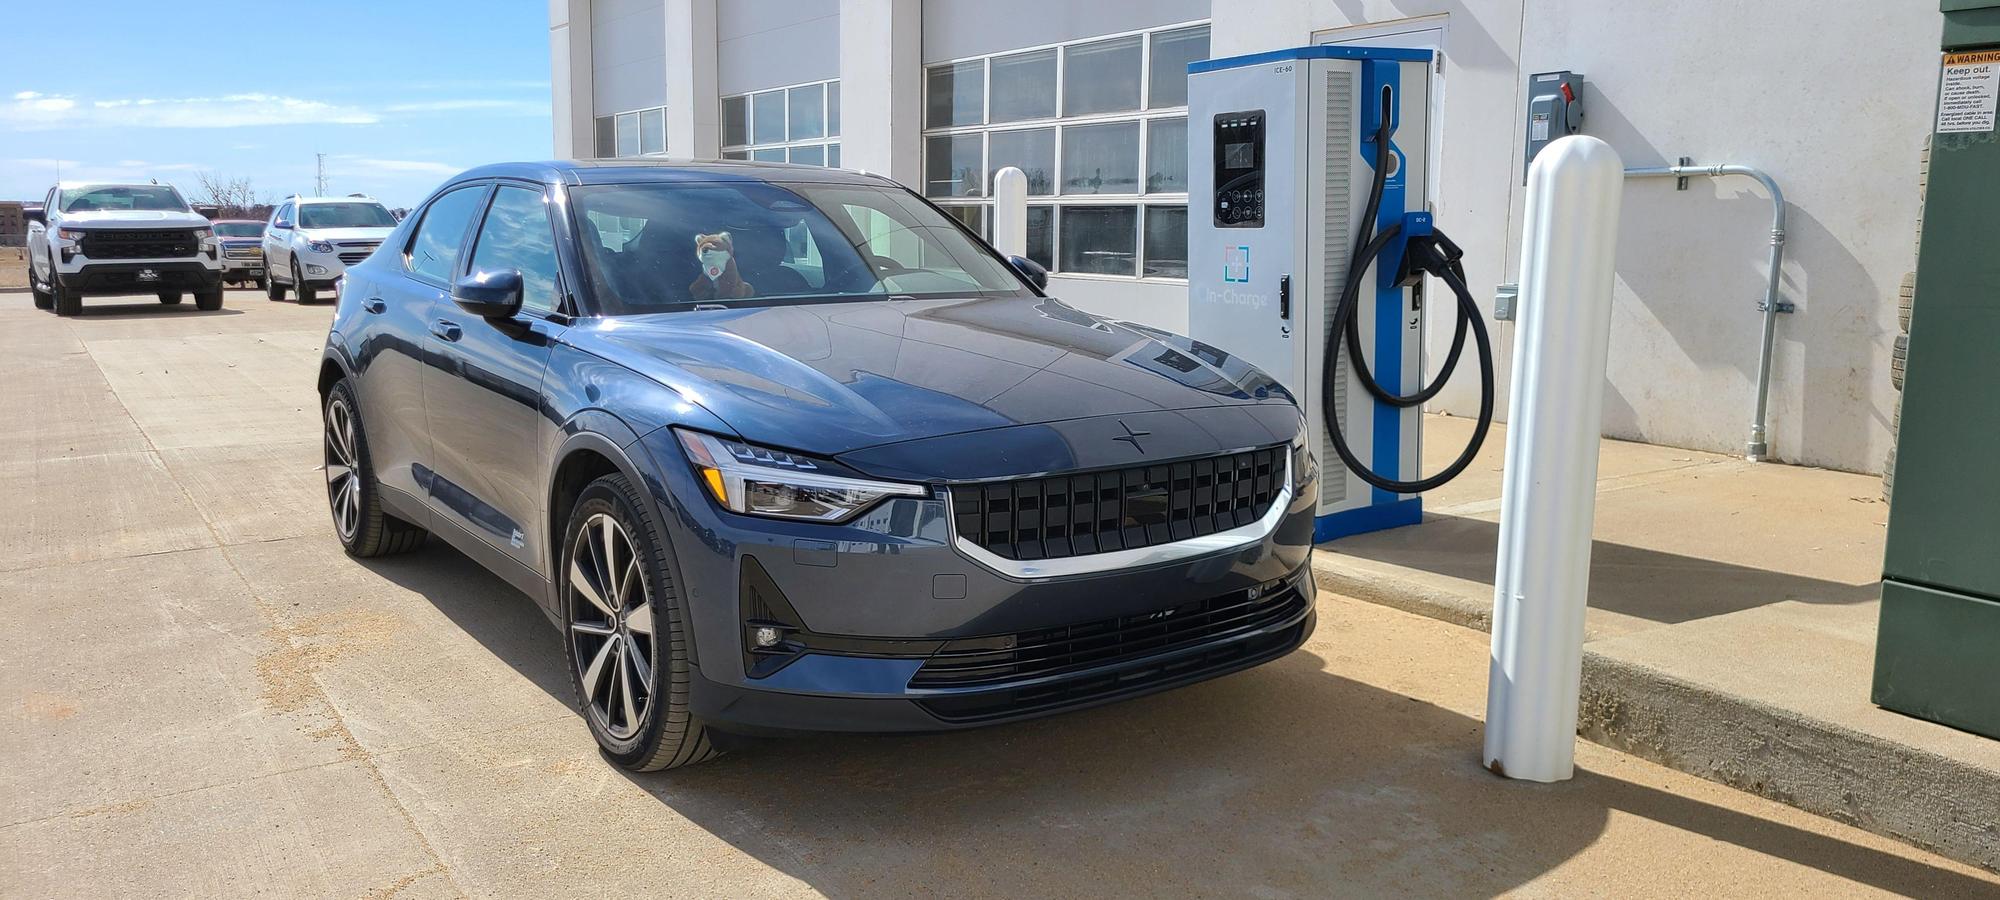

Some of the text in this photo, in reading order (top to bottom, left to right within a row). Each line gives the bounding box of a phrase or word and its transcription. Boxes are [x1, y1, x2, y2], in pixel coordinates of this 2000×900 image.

[1957, 53, 2000, 63] WARNING
[1274, 65, 1293, 73] ICE-60
[1947, 66, 1991, 76] Keep out.
[1206, 287, 1268, 310] In-Charge
